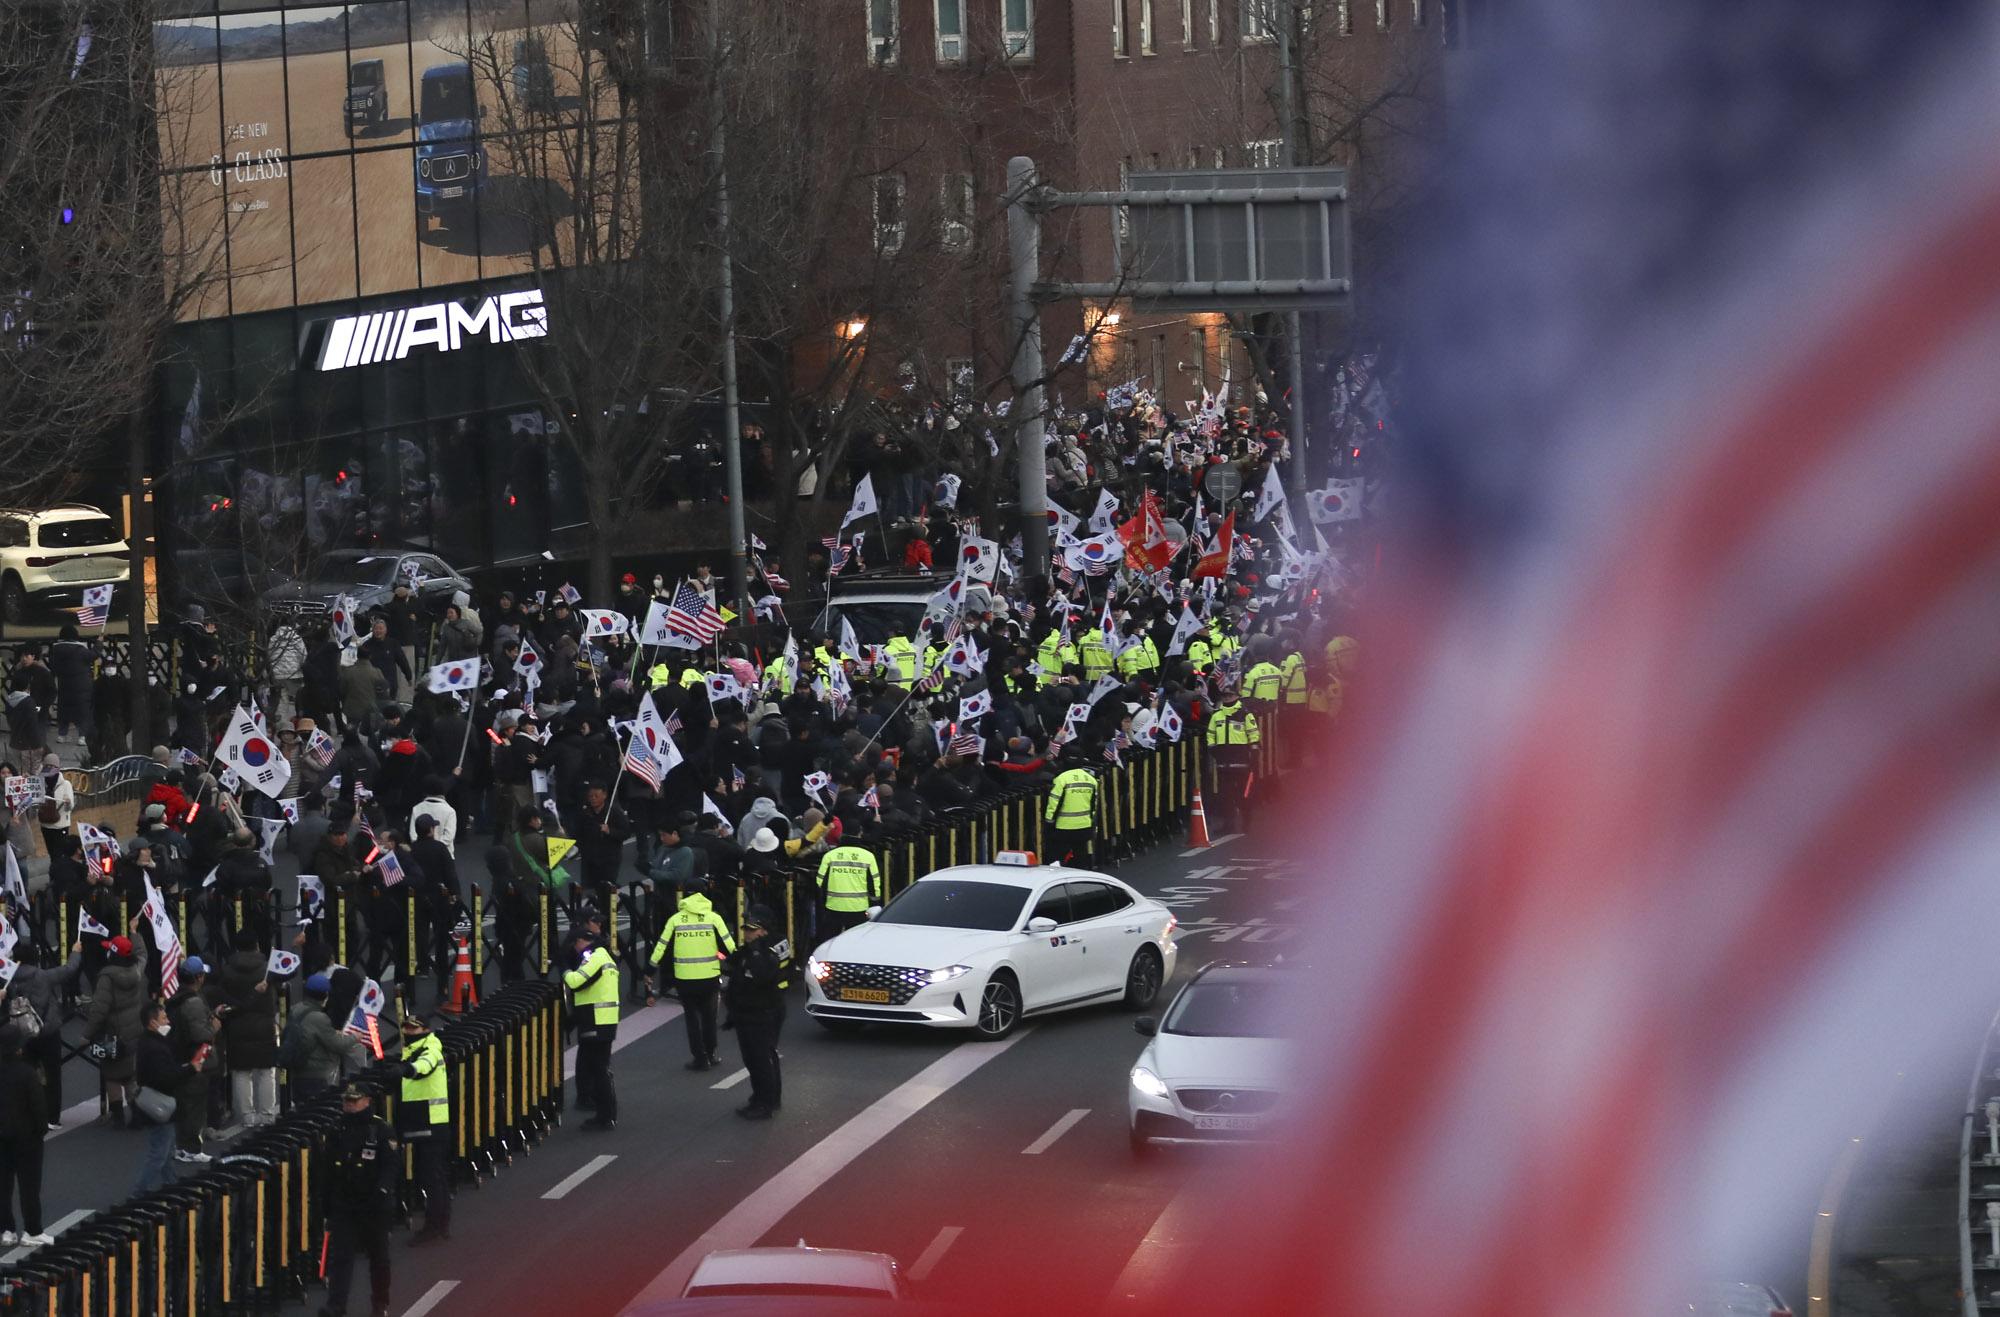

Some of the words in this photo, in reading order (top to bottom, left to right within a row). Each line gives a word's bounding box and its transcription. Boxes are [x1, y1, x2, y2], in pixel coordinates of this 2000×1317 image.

[228, 125, 245, 139] THE
[248, 122, 268, 137] NEW
[395, 289, 548, 360] AMG
[837, 852, 859, 861] 경찰
[832, 867, 863, 875] POLICE
[676, 930, 712, 938] POLICE
